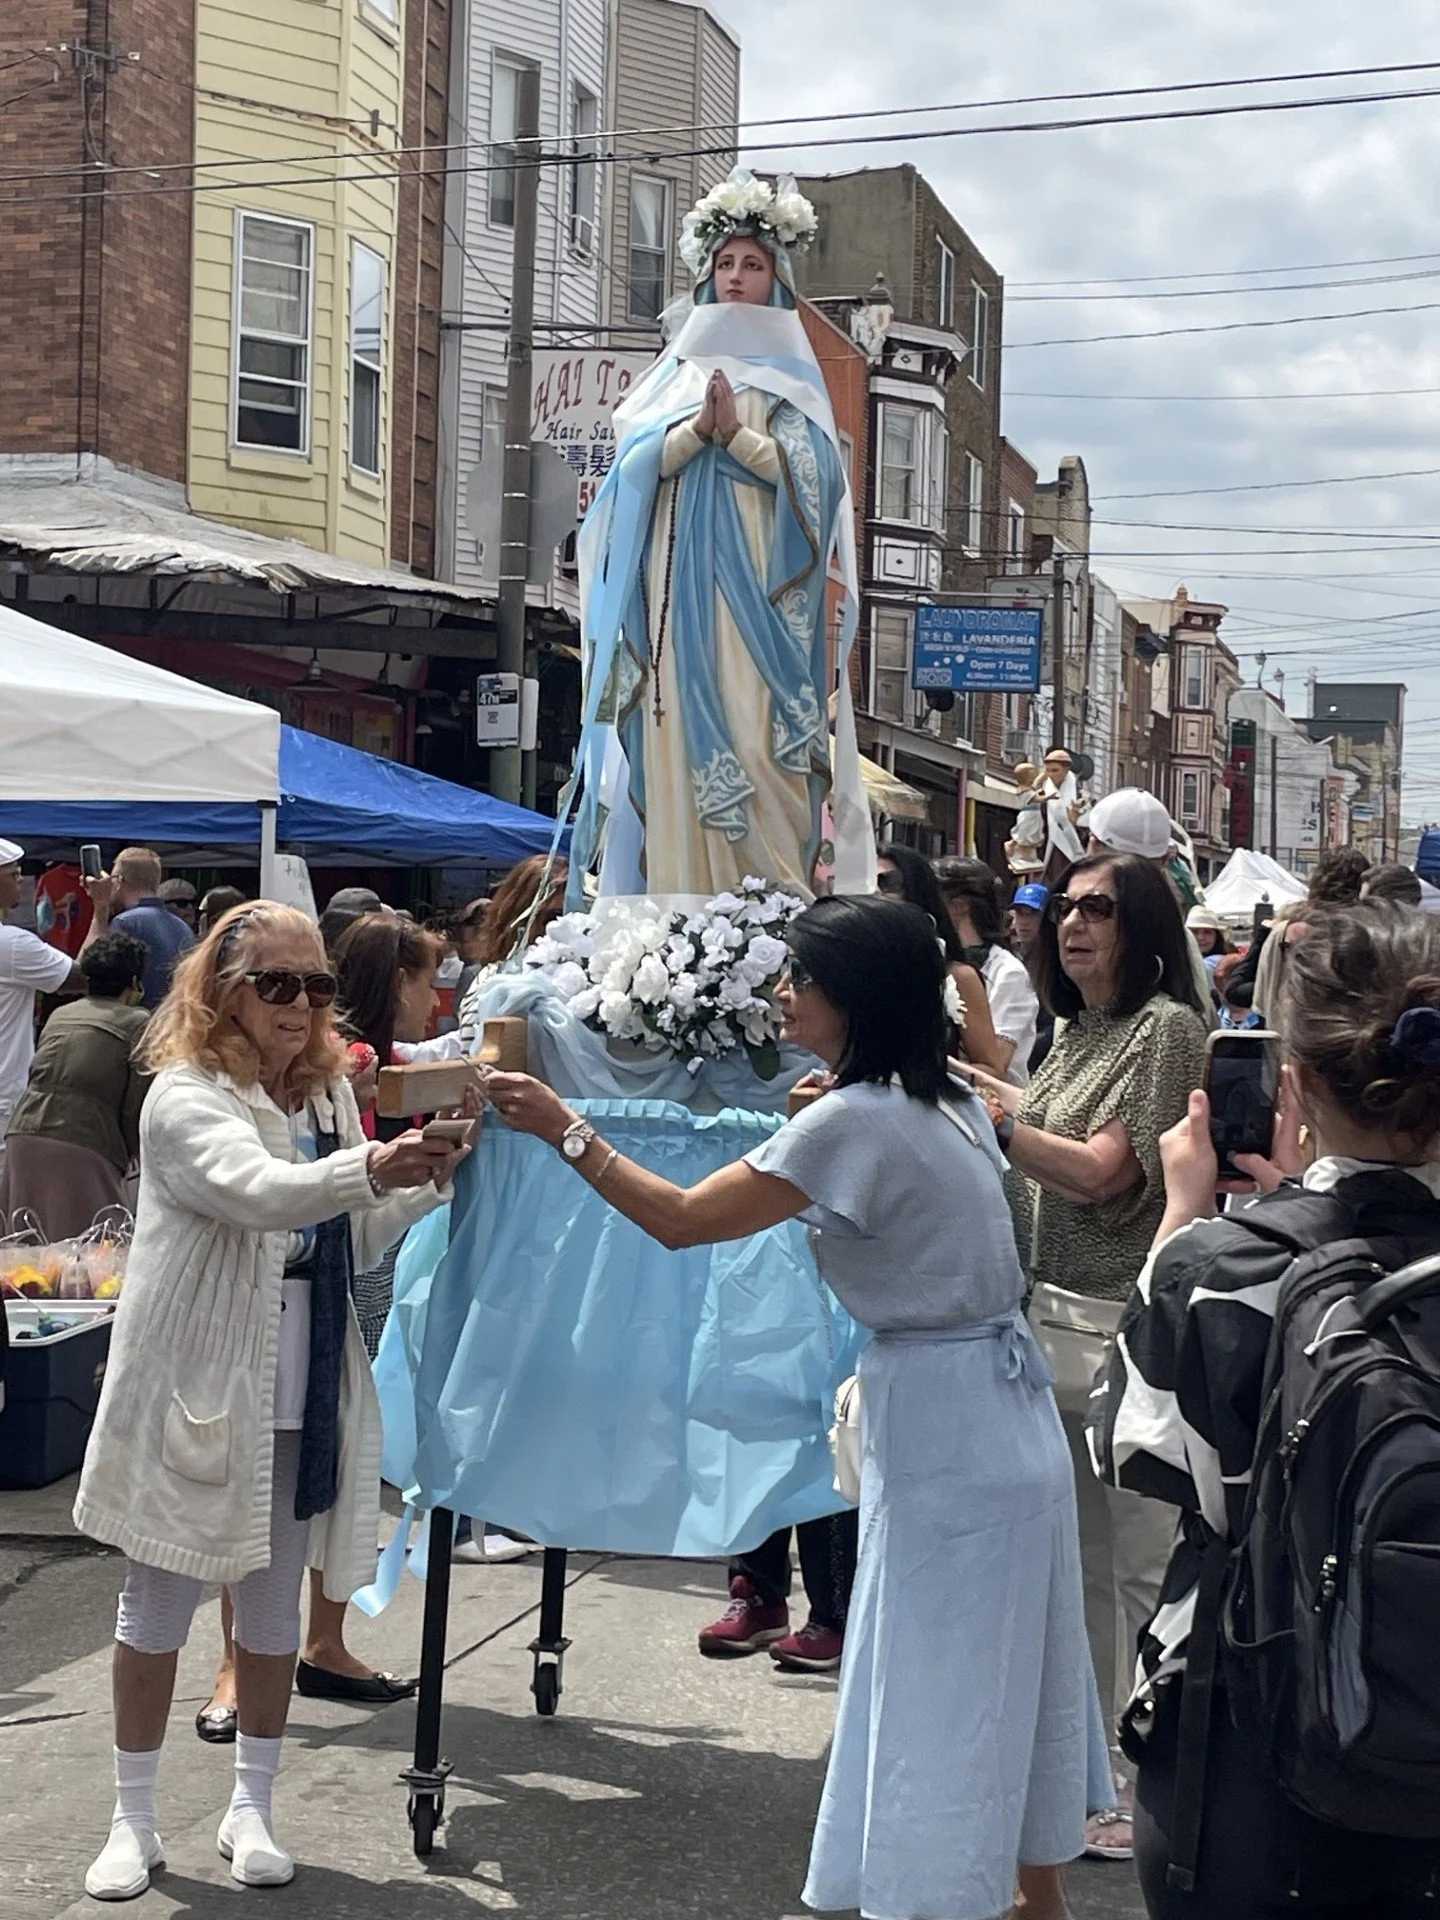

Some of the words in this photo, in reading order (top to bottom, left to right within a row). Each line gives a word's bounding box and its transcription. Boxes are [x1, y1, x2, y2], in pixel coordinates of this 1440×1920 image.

[531, 358, 584, 435] HAI
[544, 419, 583, 440] Hair
[919, 607, 1039, 631] LAUNDROMAT
[969, 659, 996, 671] Open
[998, 660, 1004, 669] 7
[1005, 661, 1029, 672] Days
